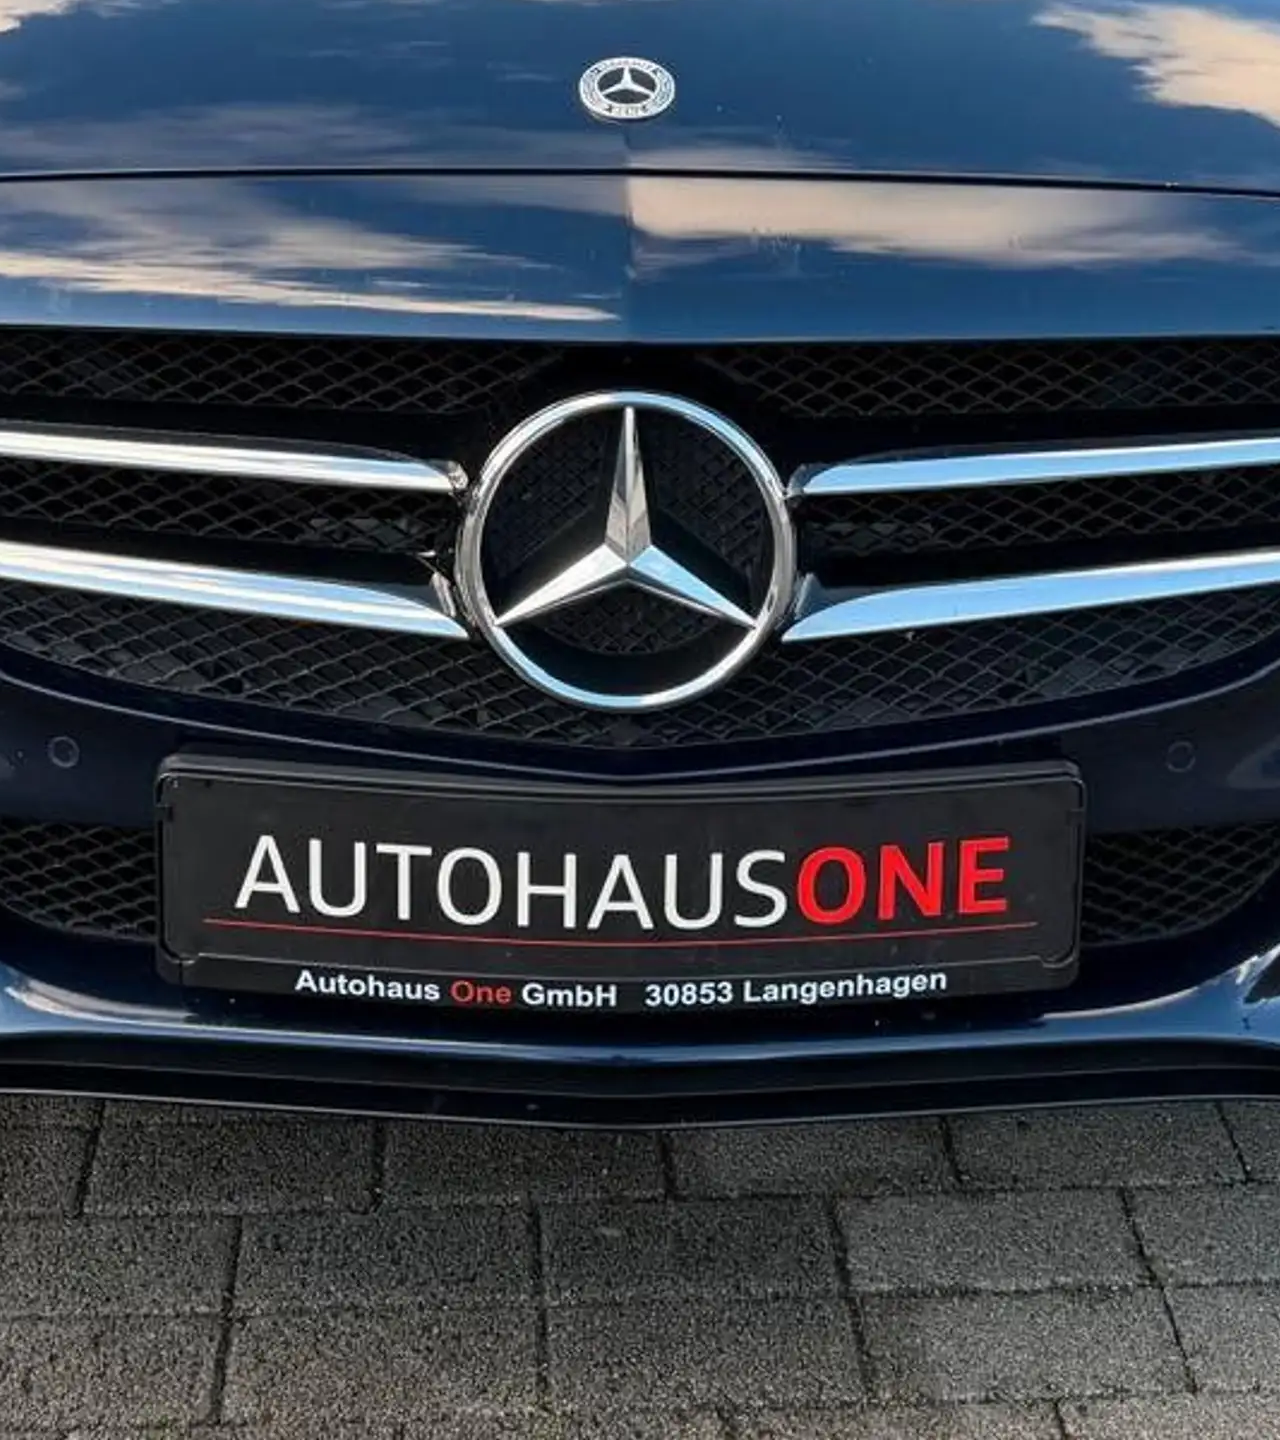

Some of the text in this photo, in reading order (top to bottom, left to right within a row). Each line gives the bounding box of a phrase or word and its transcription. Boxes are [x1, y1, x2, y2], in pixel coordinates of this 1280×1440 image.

[294, 969, 947, 1007] Autohaus One GmbH 30853 Langenhagen
